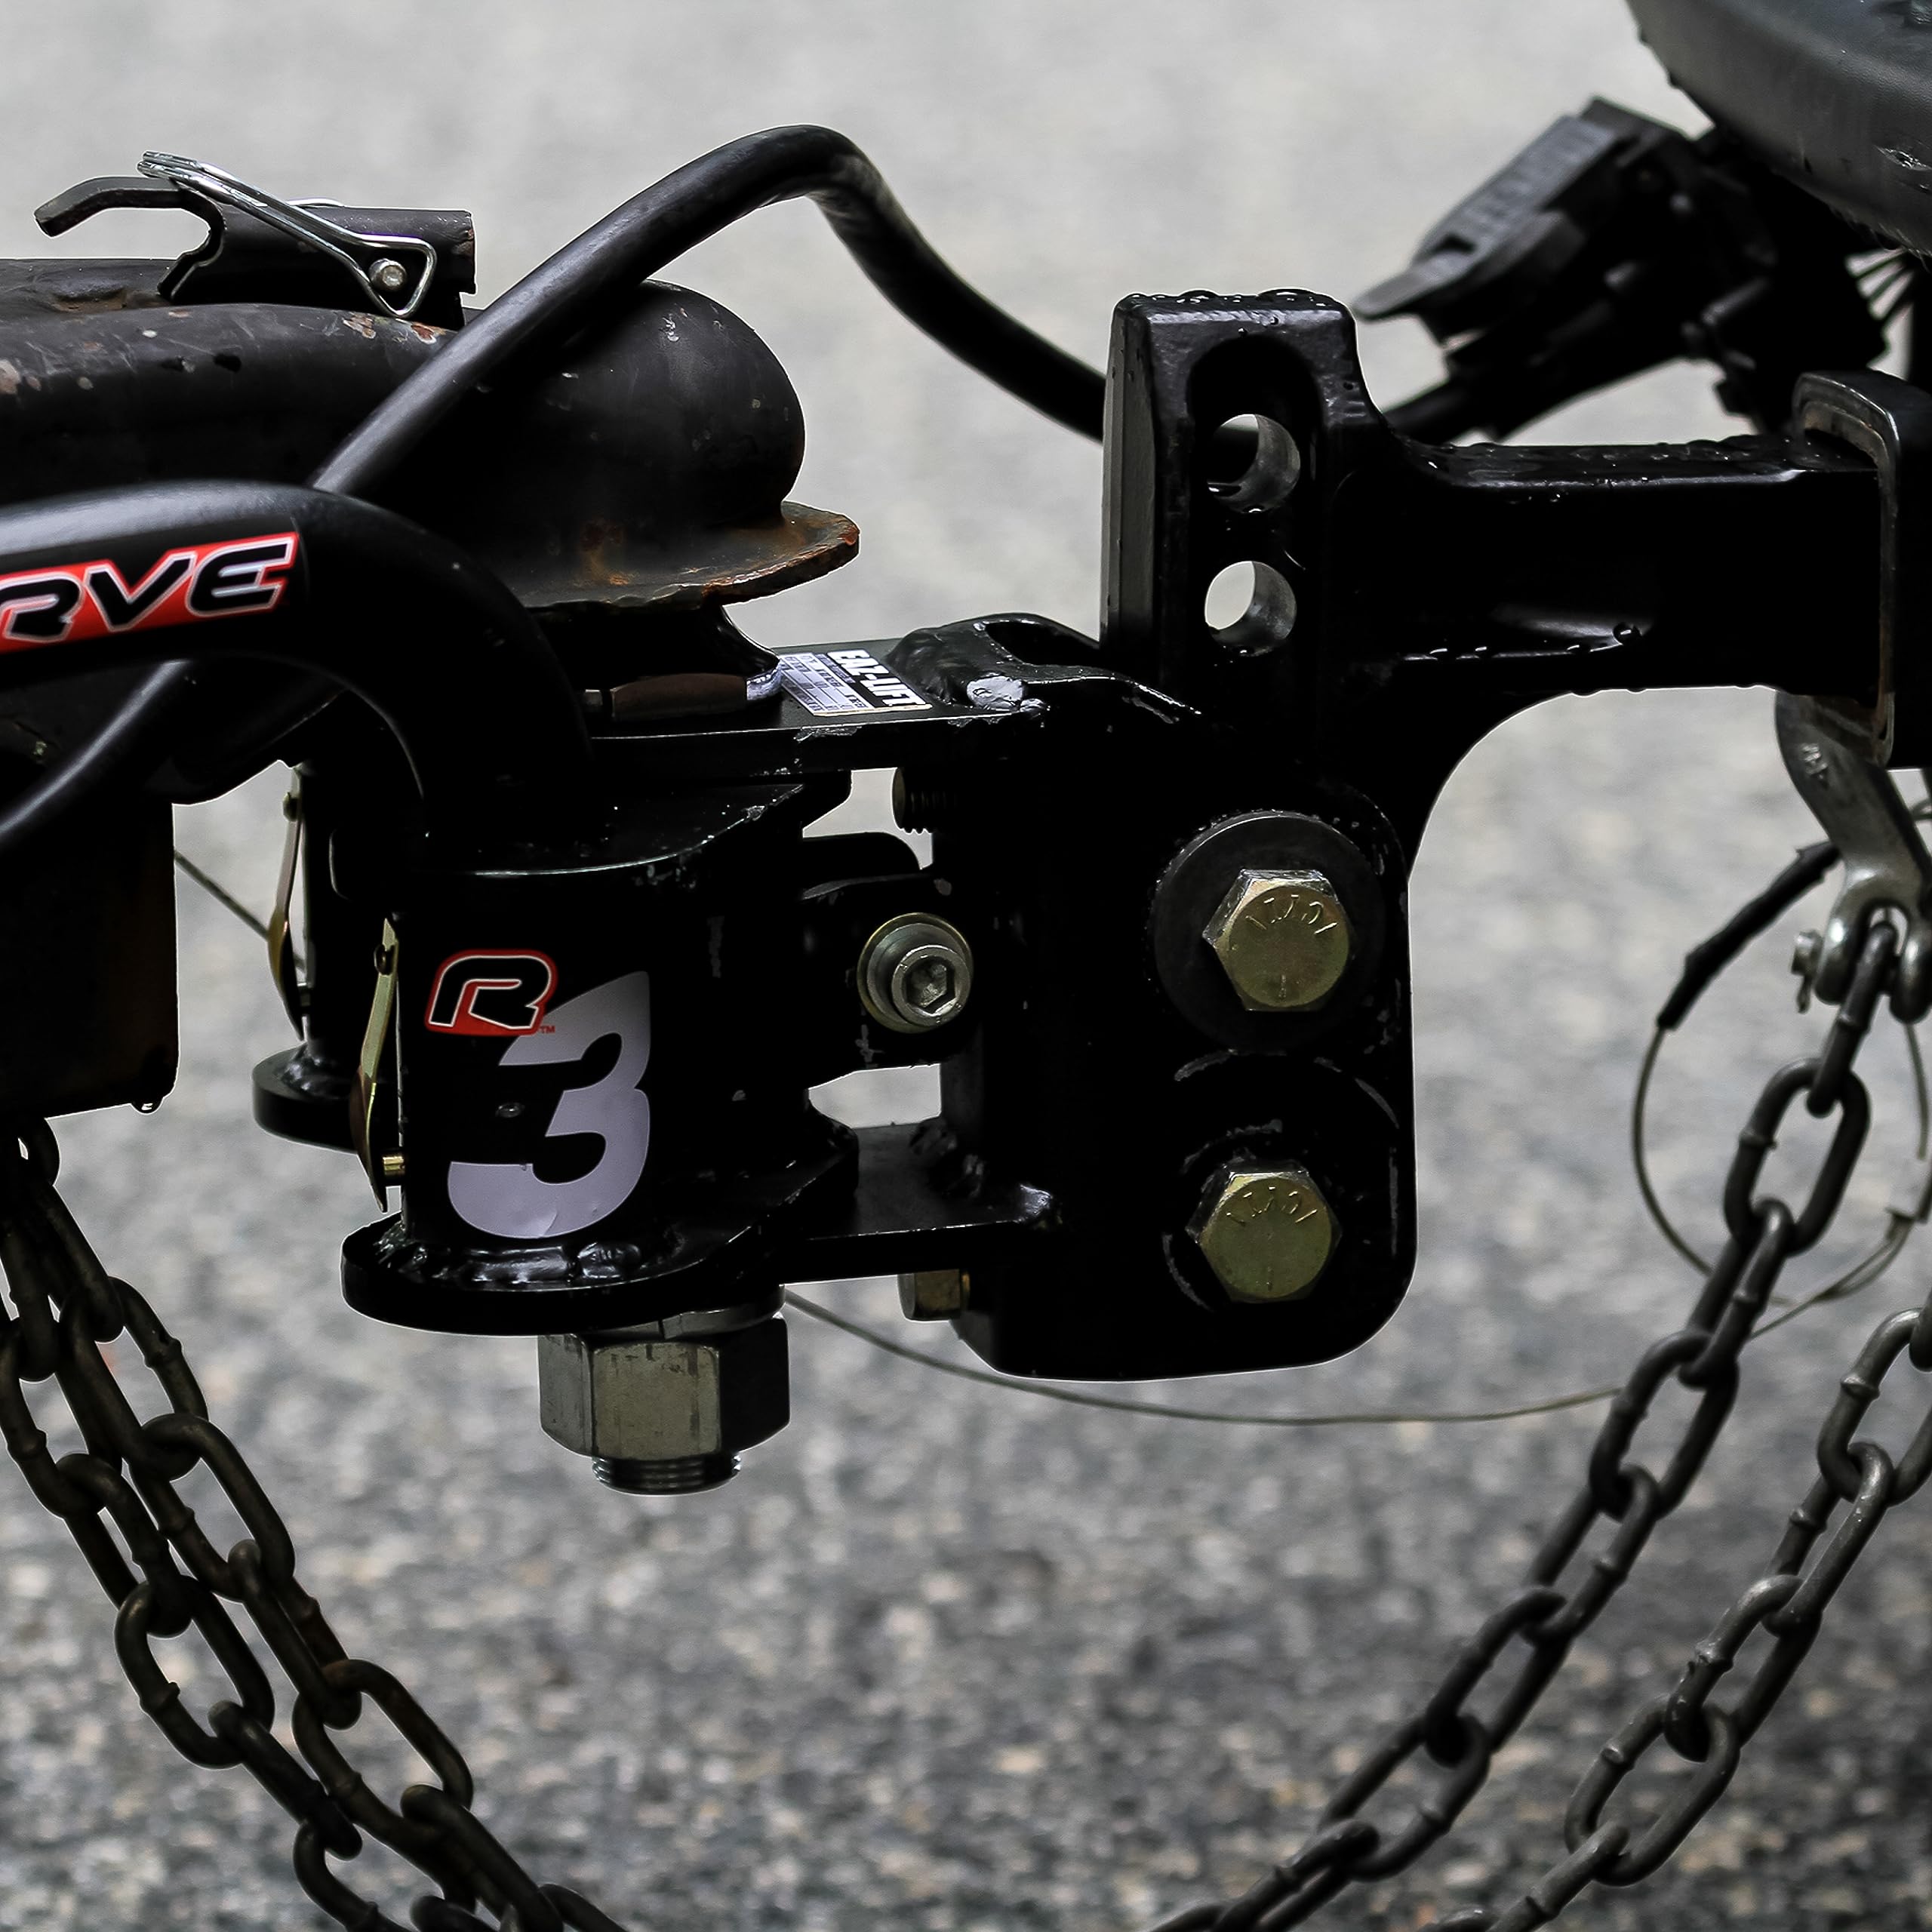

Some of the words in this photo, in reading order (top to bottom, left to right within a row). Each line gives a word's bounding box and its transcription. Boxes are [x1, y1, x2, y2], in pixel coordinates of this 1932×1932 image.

[827, 650, 926, 706] EAZ-LIFT
[428, 955, 552, 1029] R
[448, 971, 651, 1238] 3
